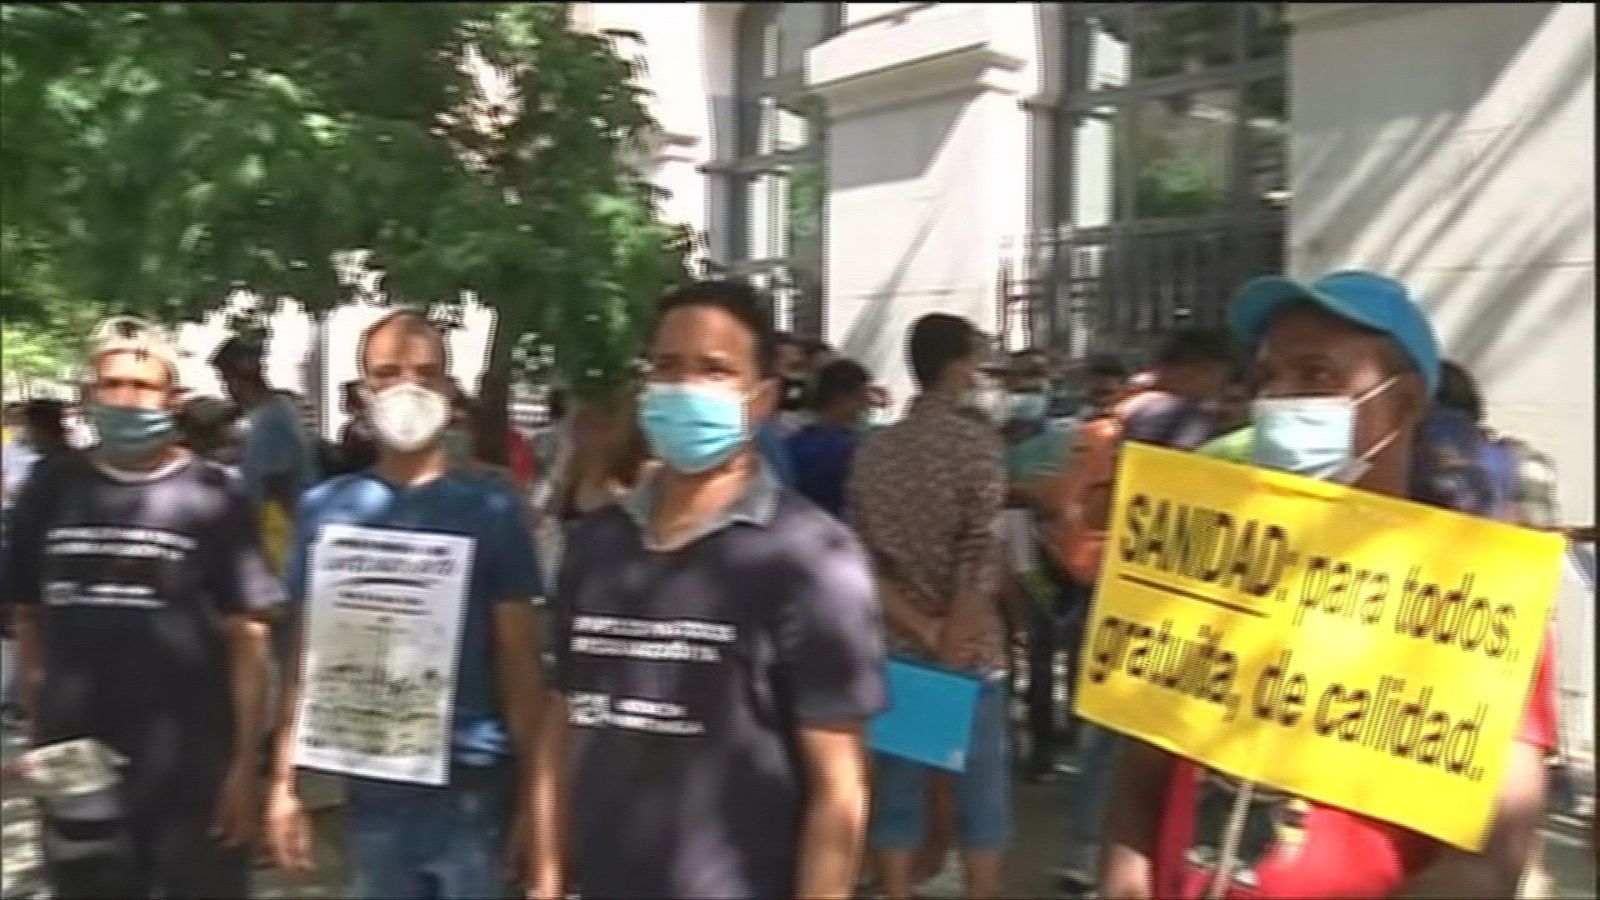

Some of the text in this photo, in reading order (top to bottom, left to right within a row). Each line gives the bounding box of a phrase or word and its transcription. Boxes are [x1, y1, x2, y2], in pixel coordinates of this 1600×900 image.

[1119, 493, 1298, 601] SANIDAD:
[1292, 556, 1390, 626] para
[1090, 615, 1239, 721] gratuita,
[1251, 649, 1308, 727] de
